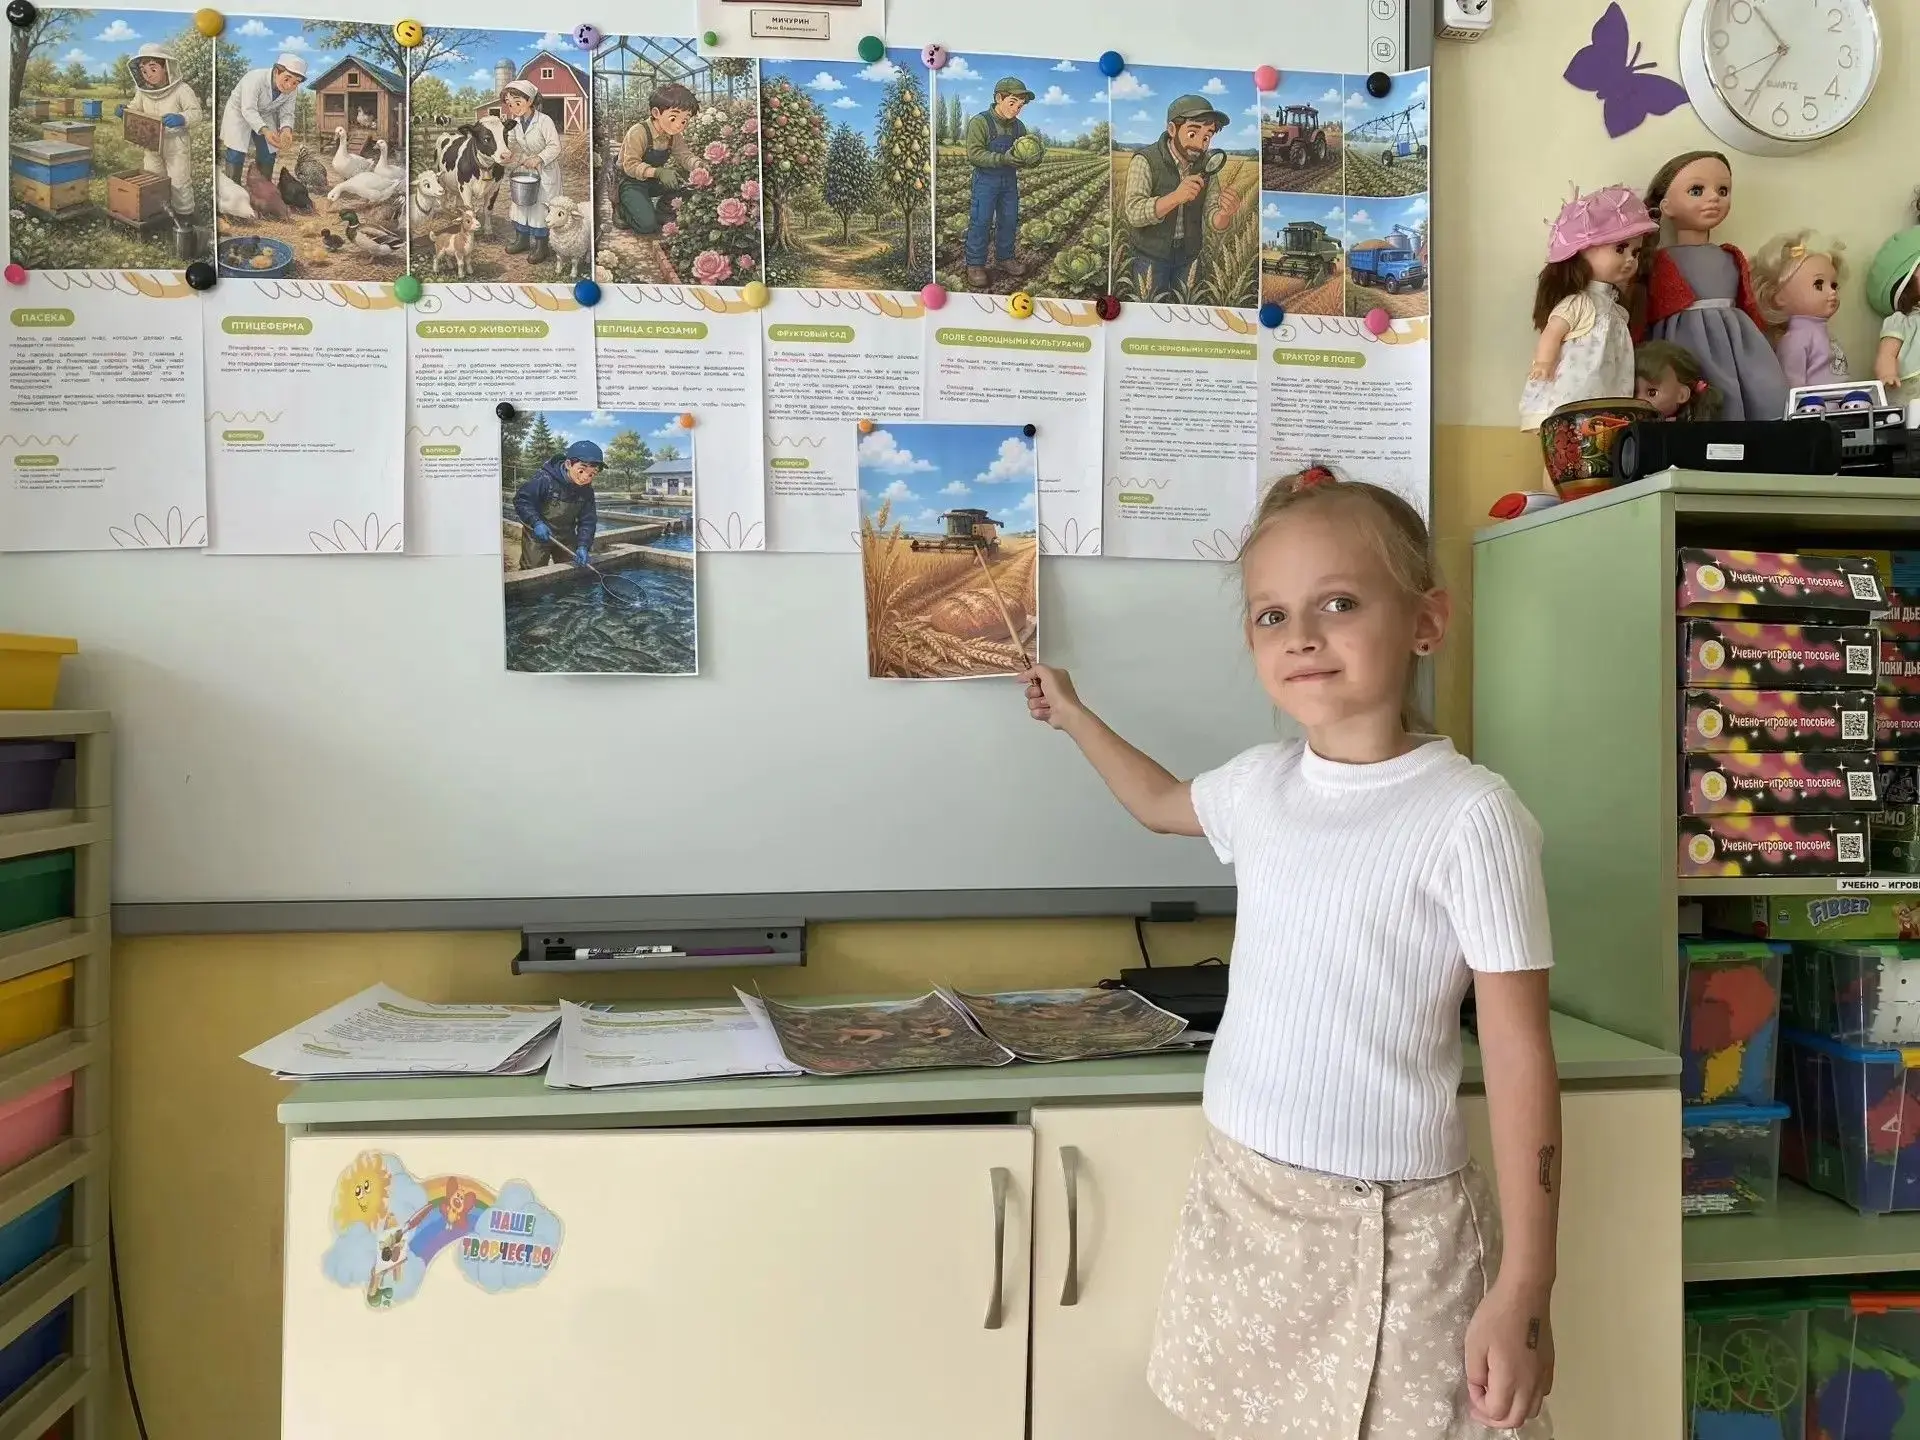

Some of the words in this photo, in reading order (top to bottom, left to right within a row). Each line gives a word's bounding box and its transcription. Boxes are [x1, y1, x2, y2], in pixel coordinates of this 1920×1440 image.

[1726, 0, 1752, 24] 10
[772, 17, 810, 25] МИЧУРИН
[1827, 9, 1843, 32] 2
[1711, 30, 1730, 56] 9
[1838, 45, 1852, 69] 3
[1723, 65, 1738, 90] 8
[1766, 80, 1799, 90] QUARTZ
[1824, 75, 1841, 100] 4
[1772, 102, 1789, 126] 6
[1801, 96, 1818, 121] 5
[424, 300, 432, 309] 4
[21, 313, 66, 322] ПАСЕКА
[231, 321, 305, 332] ПТИЦЕФЕРМА
[426, 326, 466, 334] ЗАБОТА
[480, 326, 541, 334] ЖИВОТНЫХ
[596, 326, 644, 335] ТЕПЛИЦА
[646, 326, 653, 334] С
[777, 329, 828, 338] ФРУКТОВЫЙ
[1281, 328, 1288, 337] 2
[942, 333, 965, 341] ПОЛЕ
[976, 335, 1028, 345] ОВОЩНЫМИ
[1030, 338, 1086, 348] КУЛЬТУРАМИ
[1204, 348, 1251, 356] КУЛЬТУРАМИ
[1282, 352, 1320, 362] ТРАКТОР
[1331, 356, 1356, 364] ПОЛЕ
[1730, 570, 1805, 586] Учебно-игровое
[1807, 576, 1844, 588] пособие
[1731, 646, 1802, 663] Учебно-игровое
[1804, 650, 1840, 662] пособие
[1730, 714, 1798, 729] Учебно-игровое
[1800, 717, 1835, 728] пособие
[1902, 720, 1920, 728] посо
[1732, 776, 1804, 790] Учебно-игровое
[1806, 778, 1842, 788] пособие
[1722, 839, 1793, 854] Учебно-игровое
[1796, 840, 1831, 851] пособие
[1842, 881, 1880, 889] УЧЕБНО
[1888, 881, 1920, 889] ИГРОВ
[1809, 898, 1870, 924] FIBBER
[490, 1210, 535, 1234] НАШЕ
[463, 1238, 552, 1268] ТВОРЧЕСТВО
